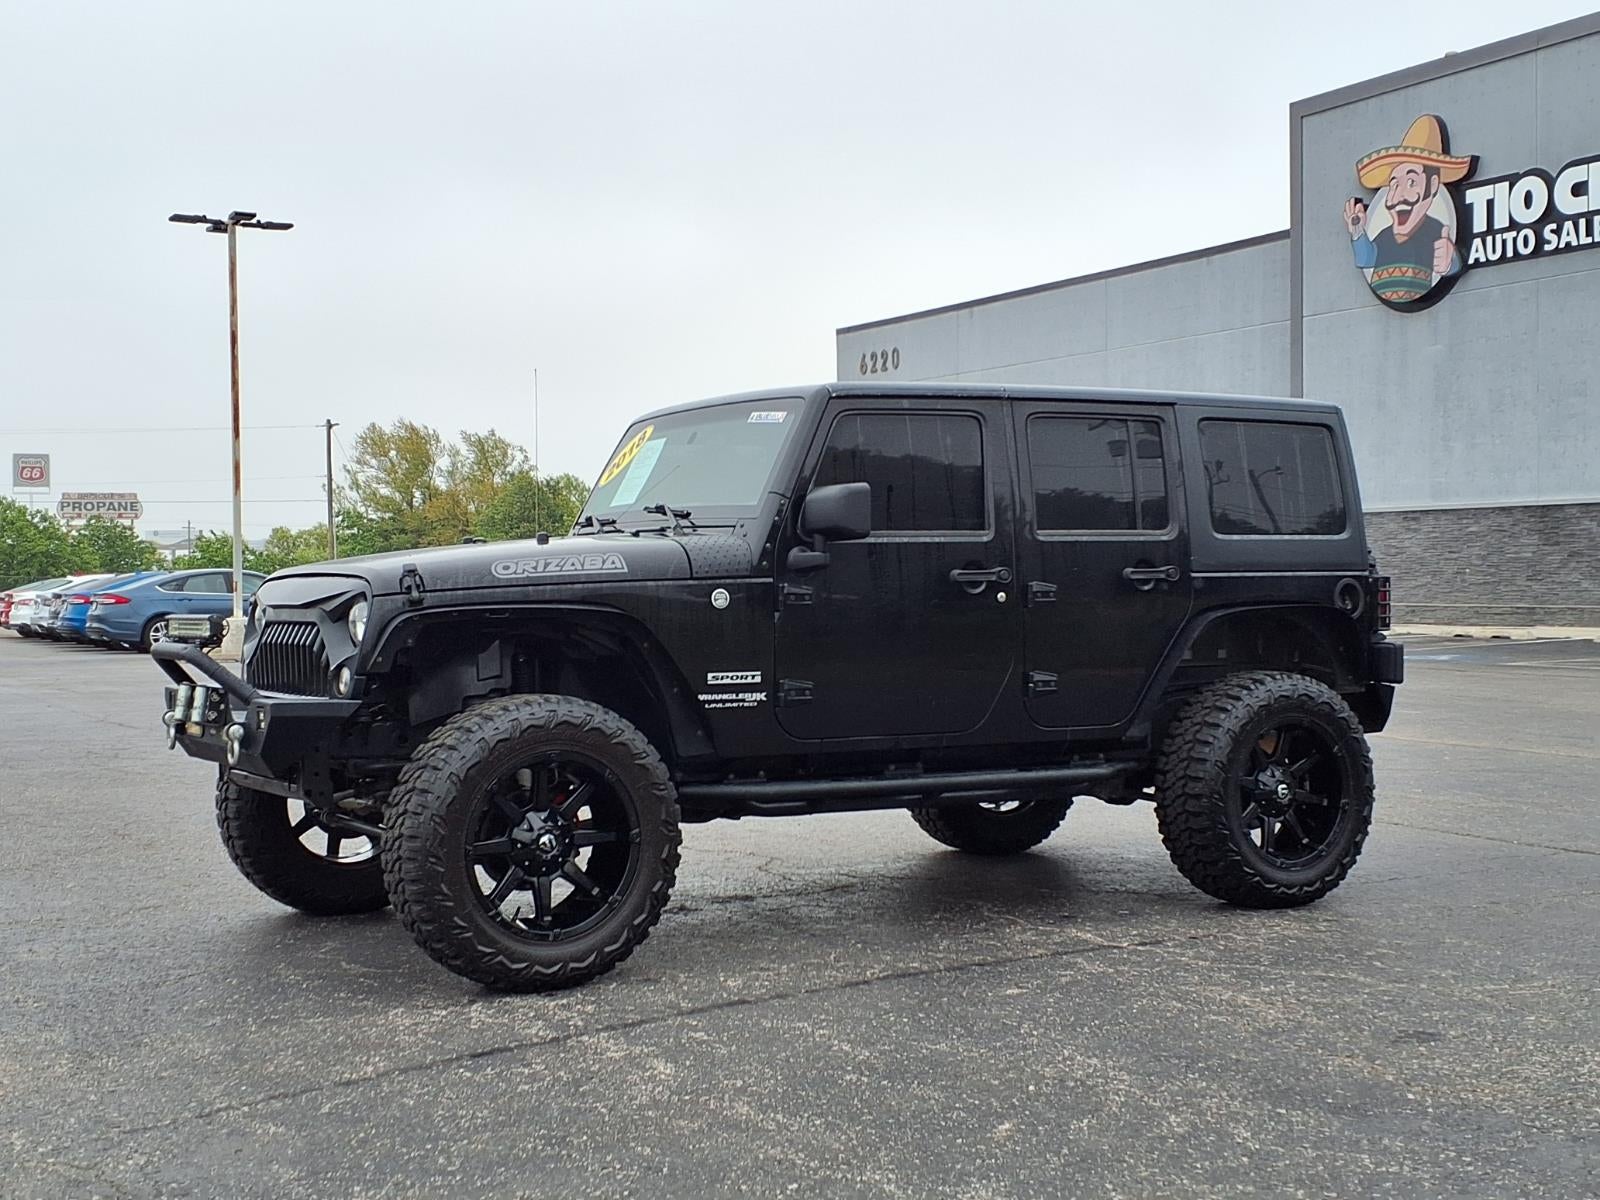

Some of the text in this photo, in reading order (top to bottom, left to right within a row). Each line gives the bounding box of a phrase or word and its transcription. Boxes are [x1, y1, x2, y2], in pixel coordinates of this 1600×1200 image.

[1465, 176, 1549, 234] TIO
[1467, 228, 1536, 265] AUTO
[860, 347, 900, 375] 6220
[22, 467, 42, 479] 66
[60, 501, 139, 512] PROPANE
[491, 553, 628, 578] ORIZABA
